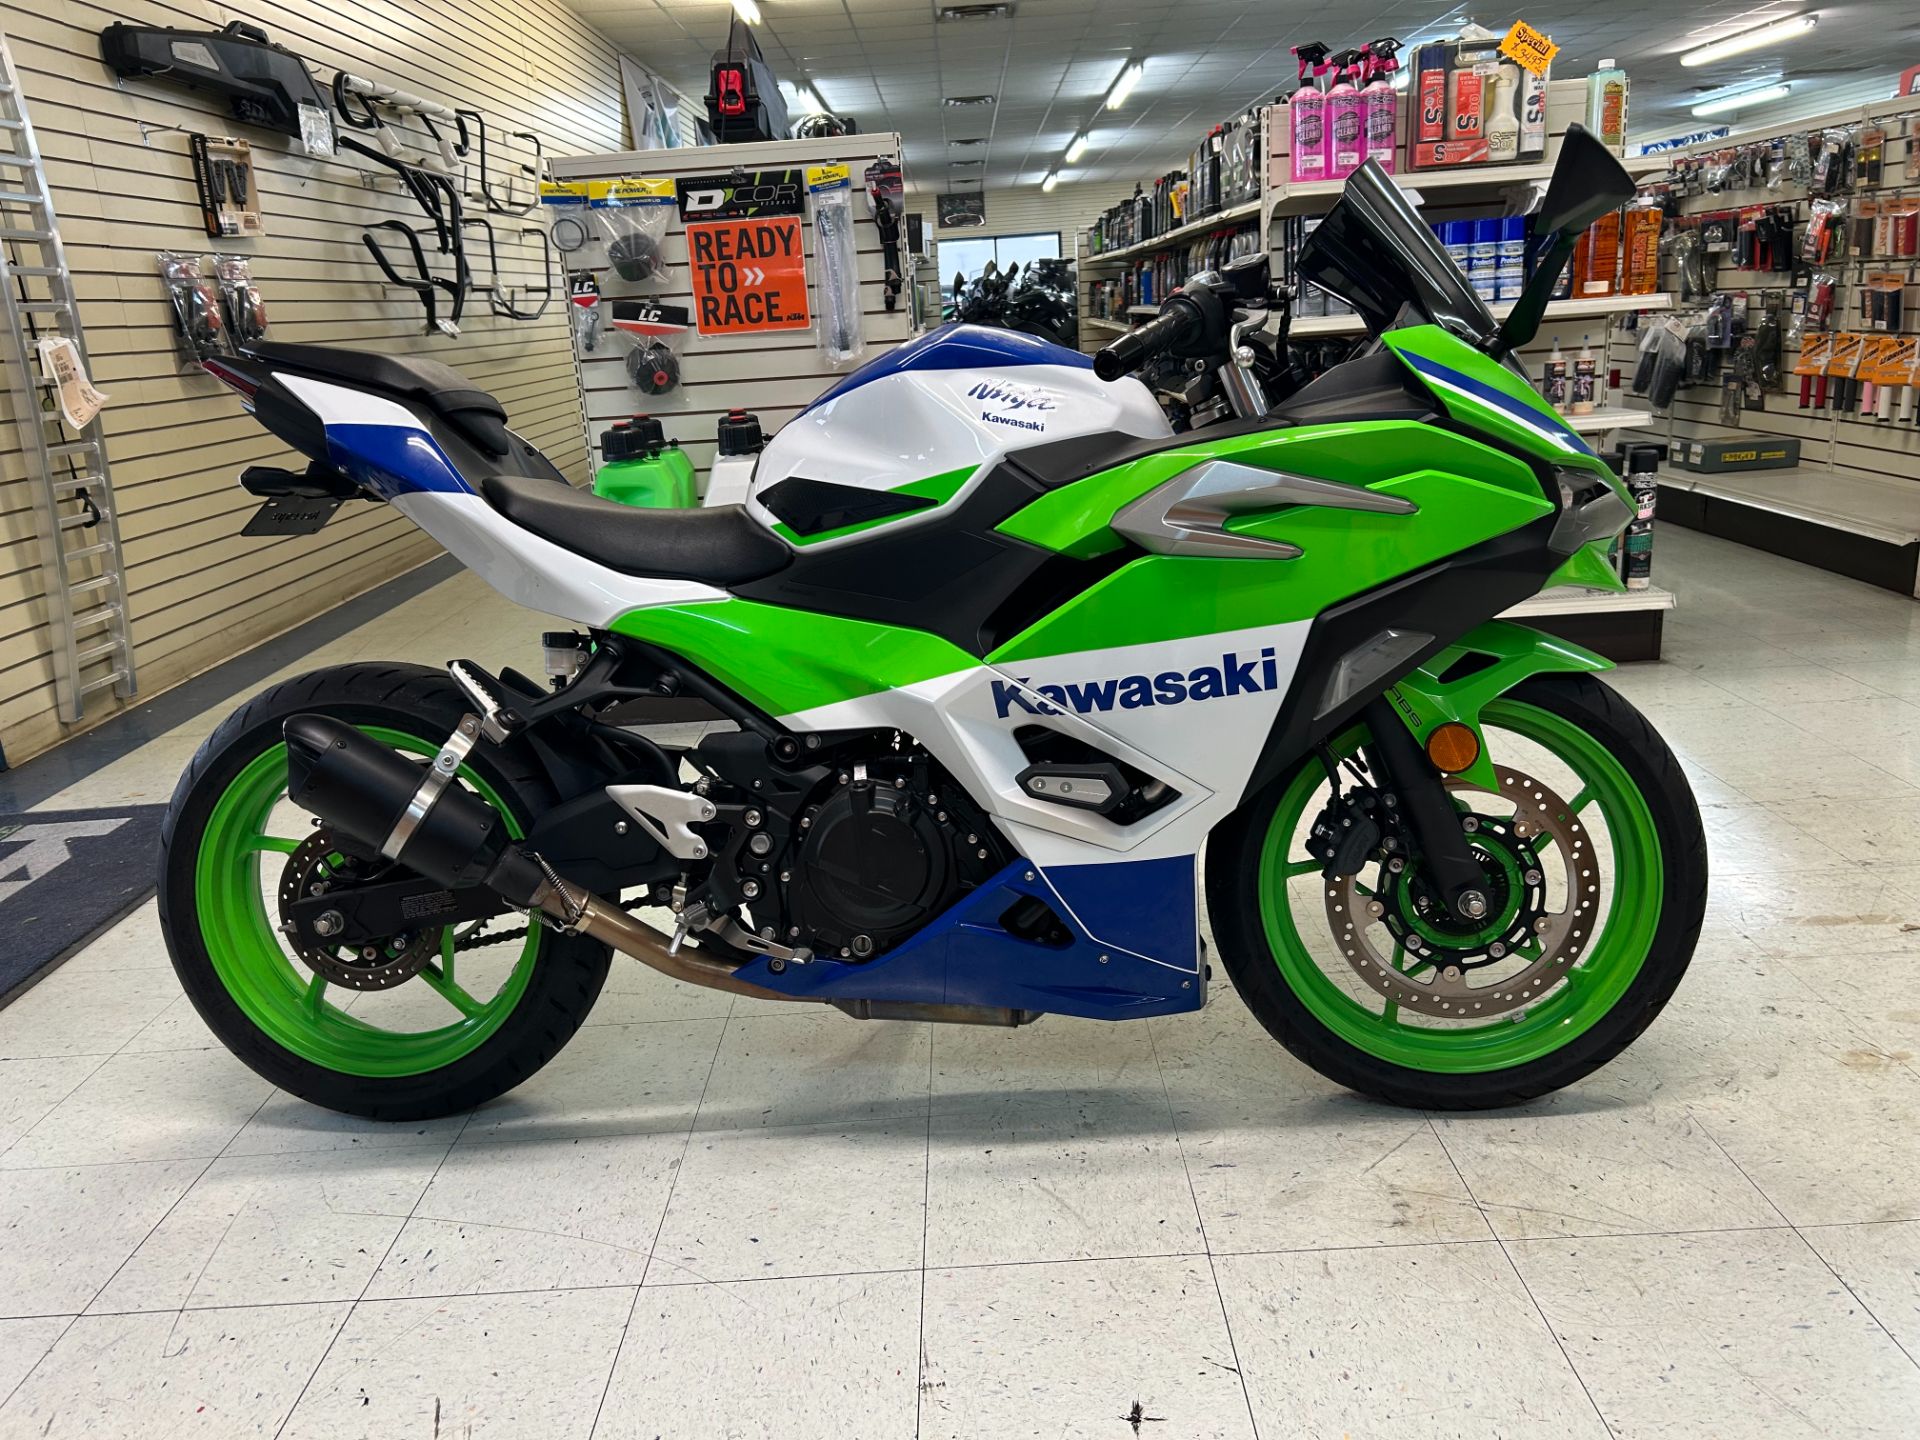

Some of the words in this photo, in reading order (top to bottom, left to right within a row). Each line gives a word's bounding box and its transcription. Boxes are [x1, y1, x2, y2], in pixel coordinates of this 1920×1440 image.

[1516, 27, 1551, 57] Special
[199, 160, 208, 186] HANDLEBAR
[622, 186, 647, 194] POWER
[693, 224, 796, 263] READY
[1632, 235, 1647, 273] SPOT
[1646, 235, 1658, 270] WATER
[573, 281, 594, 294] LC
[697, 262, 738, 294] TO
[638, 309, 662, 322] LC
[702, 291, 784, 326] RACE
[786, 313, 805, 321] KTM
[968, 378, 1056, 412] Ninja
[982, 412, 1045, 432] Kawasaki
[990, 647, 1278, 719] Kawasaki
[1390, 686, 1423, 728] ABS
